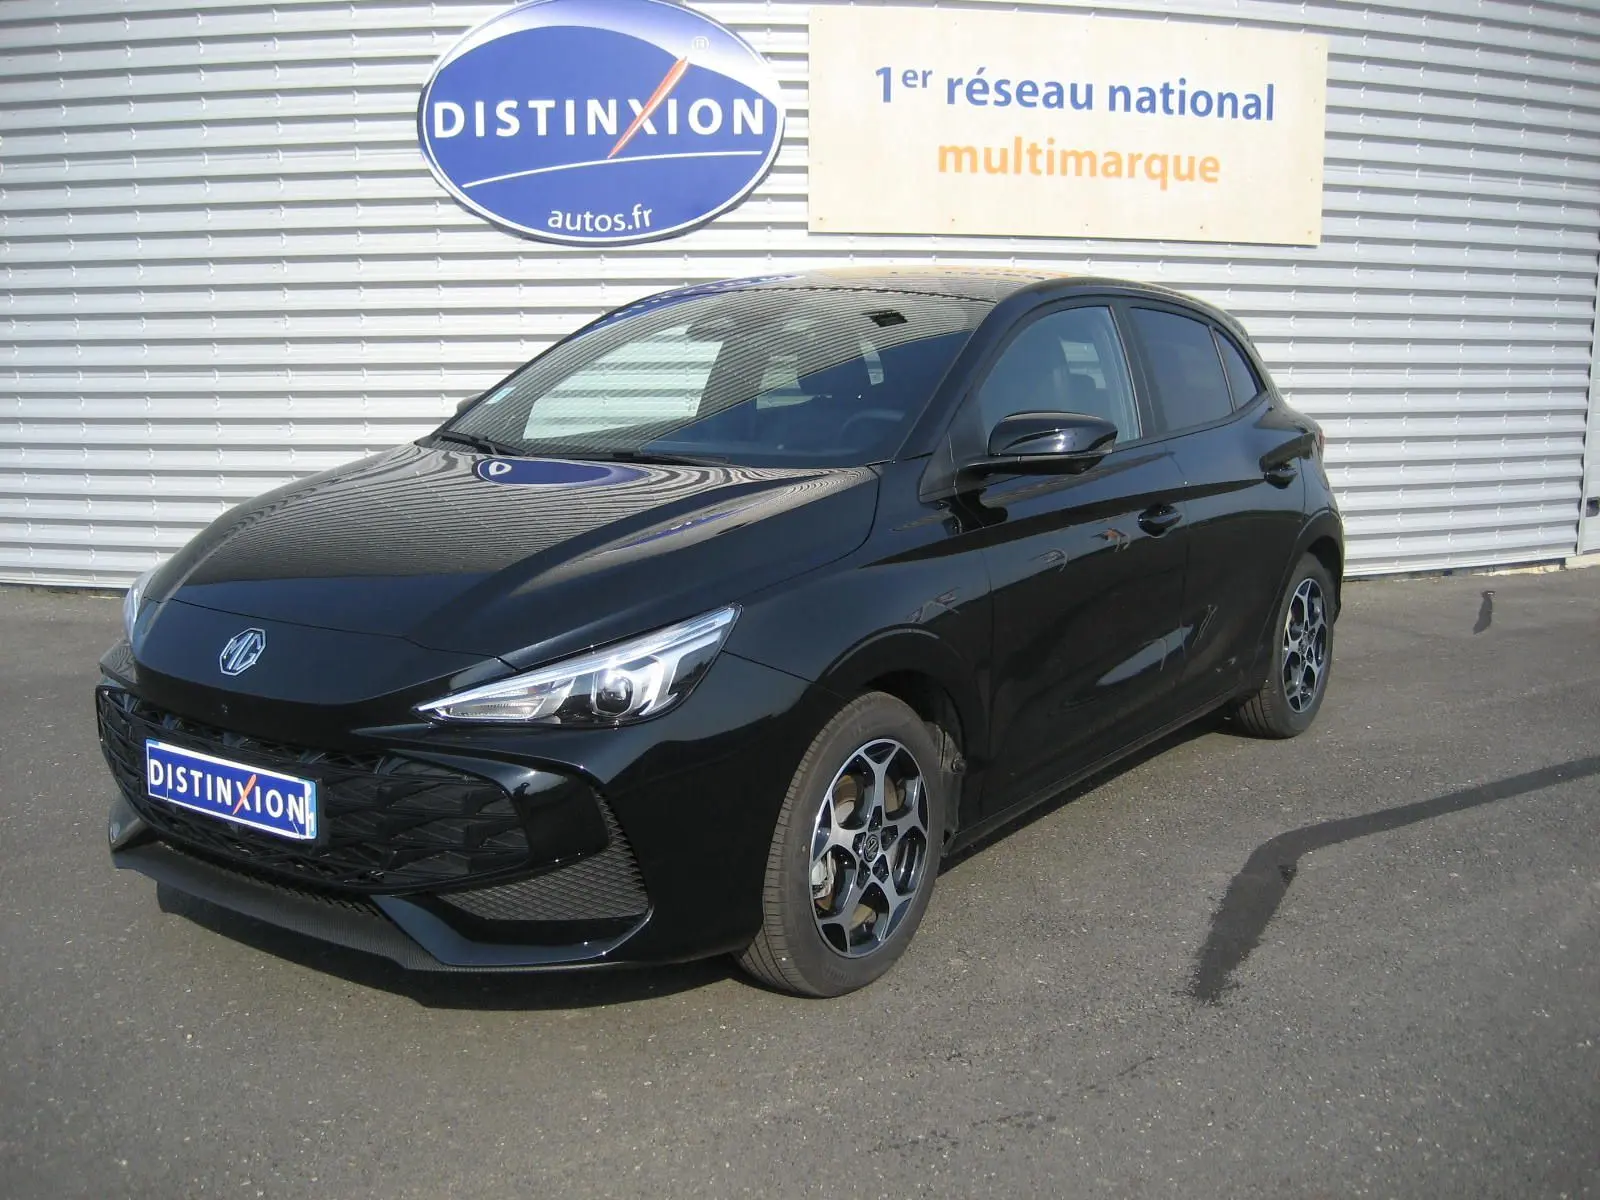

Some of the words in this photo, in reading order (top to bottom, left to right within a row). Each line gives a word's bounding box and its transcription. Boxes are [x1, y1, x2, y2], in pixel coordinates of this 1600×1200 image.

[874, 66, 933, 104] 1er
[945, 67, 1094, 110] réseau
[1108, 78, 1275, 121] national
[434, 97, 764, 139] DISTINXION
[938, 136, 1221, 191] multimarque
[547, 204, 652, 233] autos.fr
[223, 632, 263, 671] MG
[149, 758, 305, 825] DISTINXION
